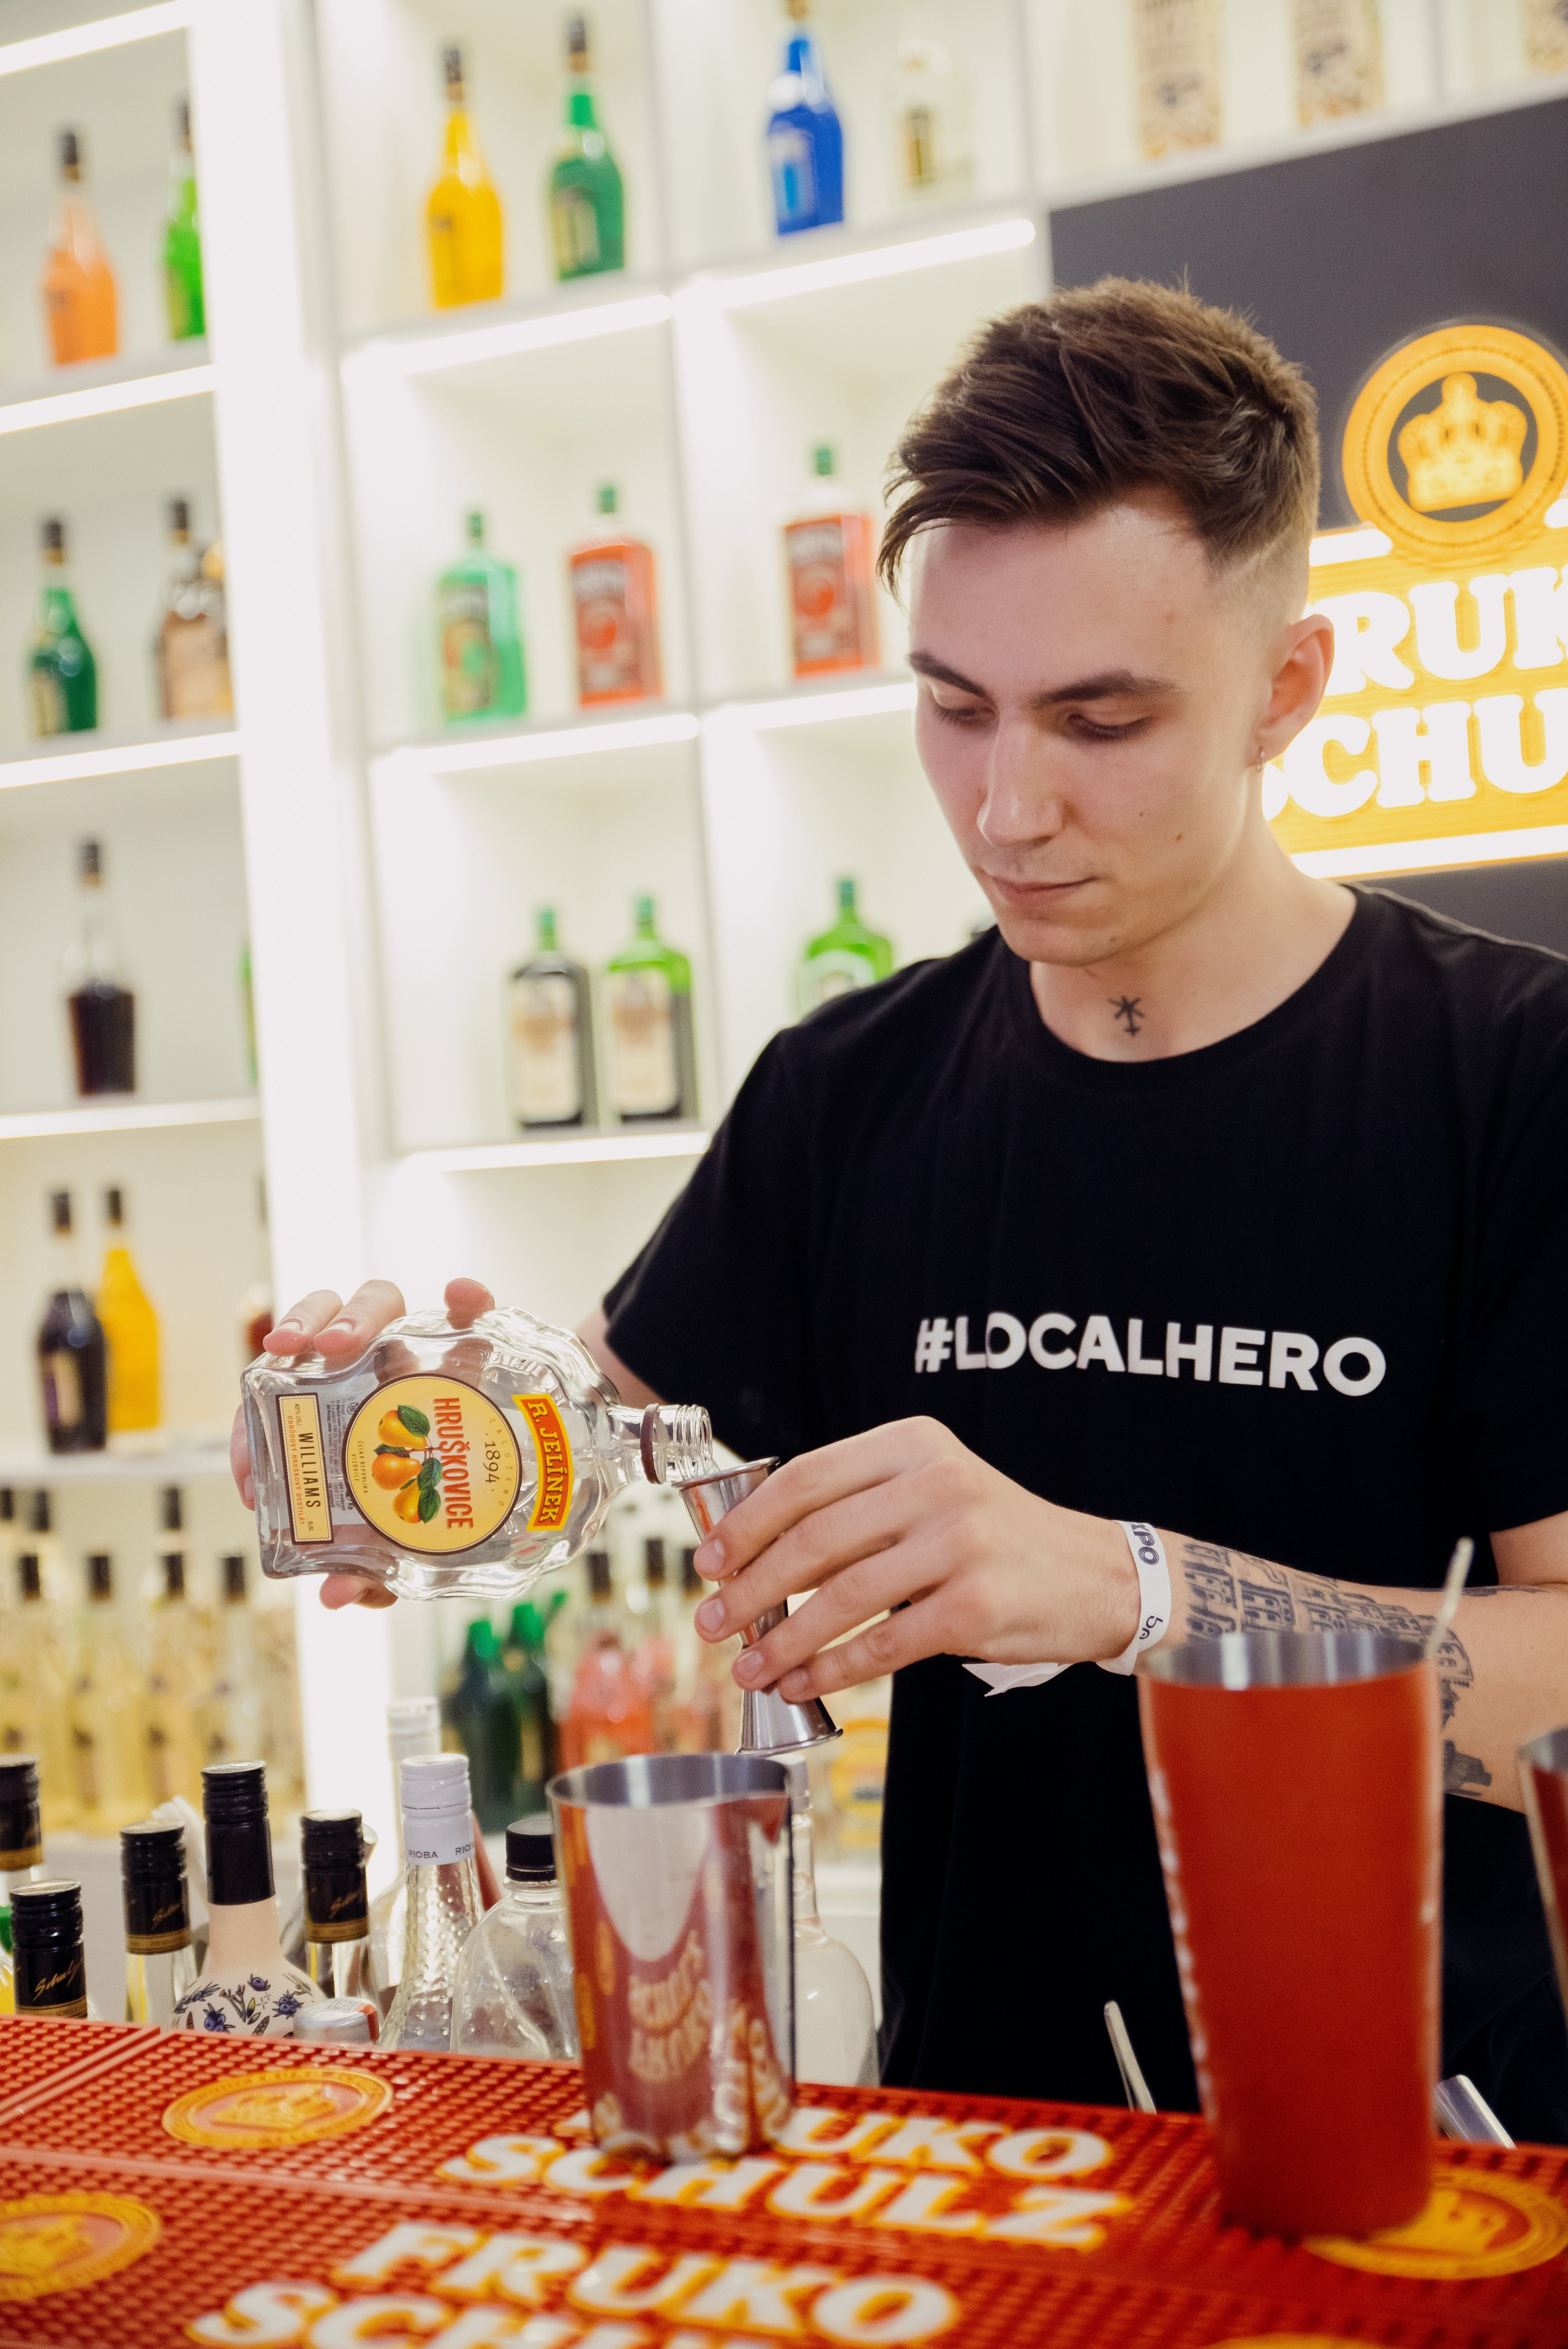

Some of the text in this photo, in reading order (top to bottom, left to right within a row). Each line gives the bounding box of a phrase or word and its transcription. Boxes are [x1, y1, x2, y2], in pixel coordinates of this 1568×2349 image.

[914, 1311, 1387, 1397] #LOCALHERO
[292, 1455, 301, 1490] HRUŠKOVÝ
[298, 1432, 321, 1507] WILLIAMS
[432, 1398, 474, 1529] HRUŠKOVICE
[539, 1427, 569, 1522] JELÍNEK
[296, 1493, 305, 1525] DESTILÁT
[408, 1850, 439, 1859] RIOBA
[332, 2220, 959, 2346] FRUKO
